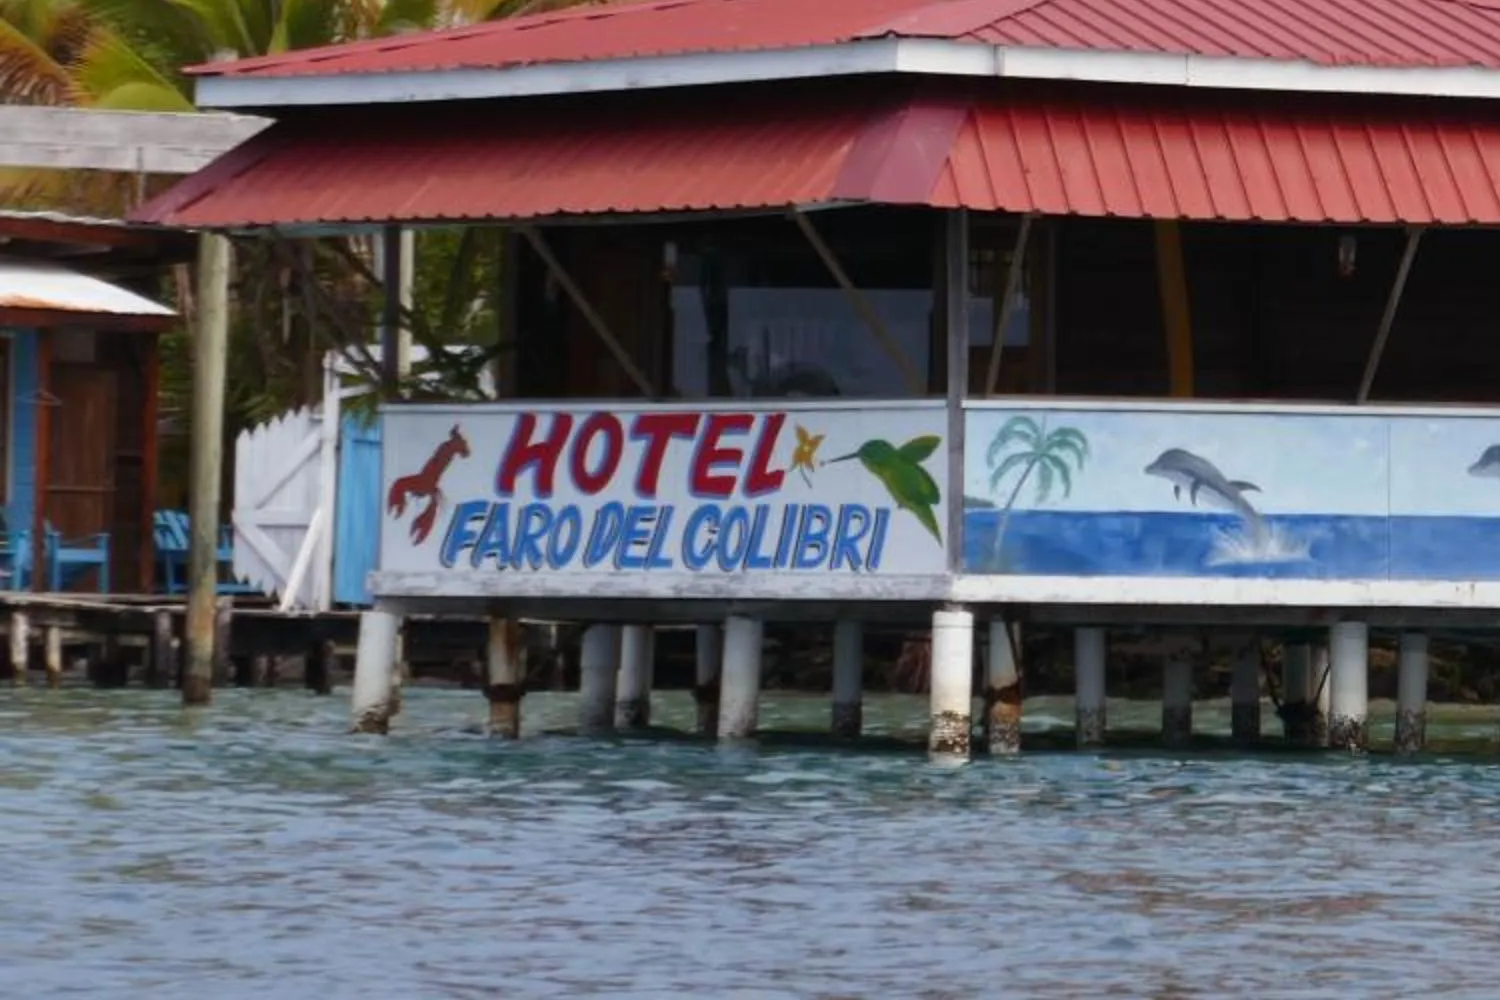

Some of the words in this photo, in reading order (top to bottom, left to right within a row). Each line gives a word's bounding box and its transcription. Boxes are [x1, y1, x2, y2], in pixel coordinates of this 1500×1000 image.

[494, 411, 786, 499] HOTEL
[440, 499, 582, 569] FARO
[583, 500, 674, 570] DEL
[683, 502, 889, 573] COLIBRI
